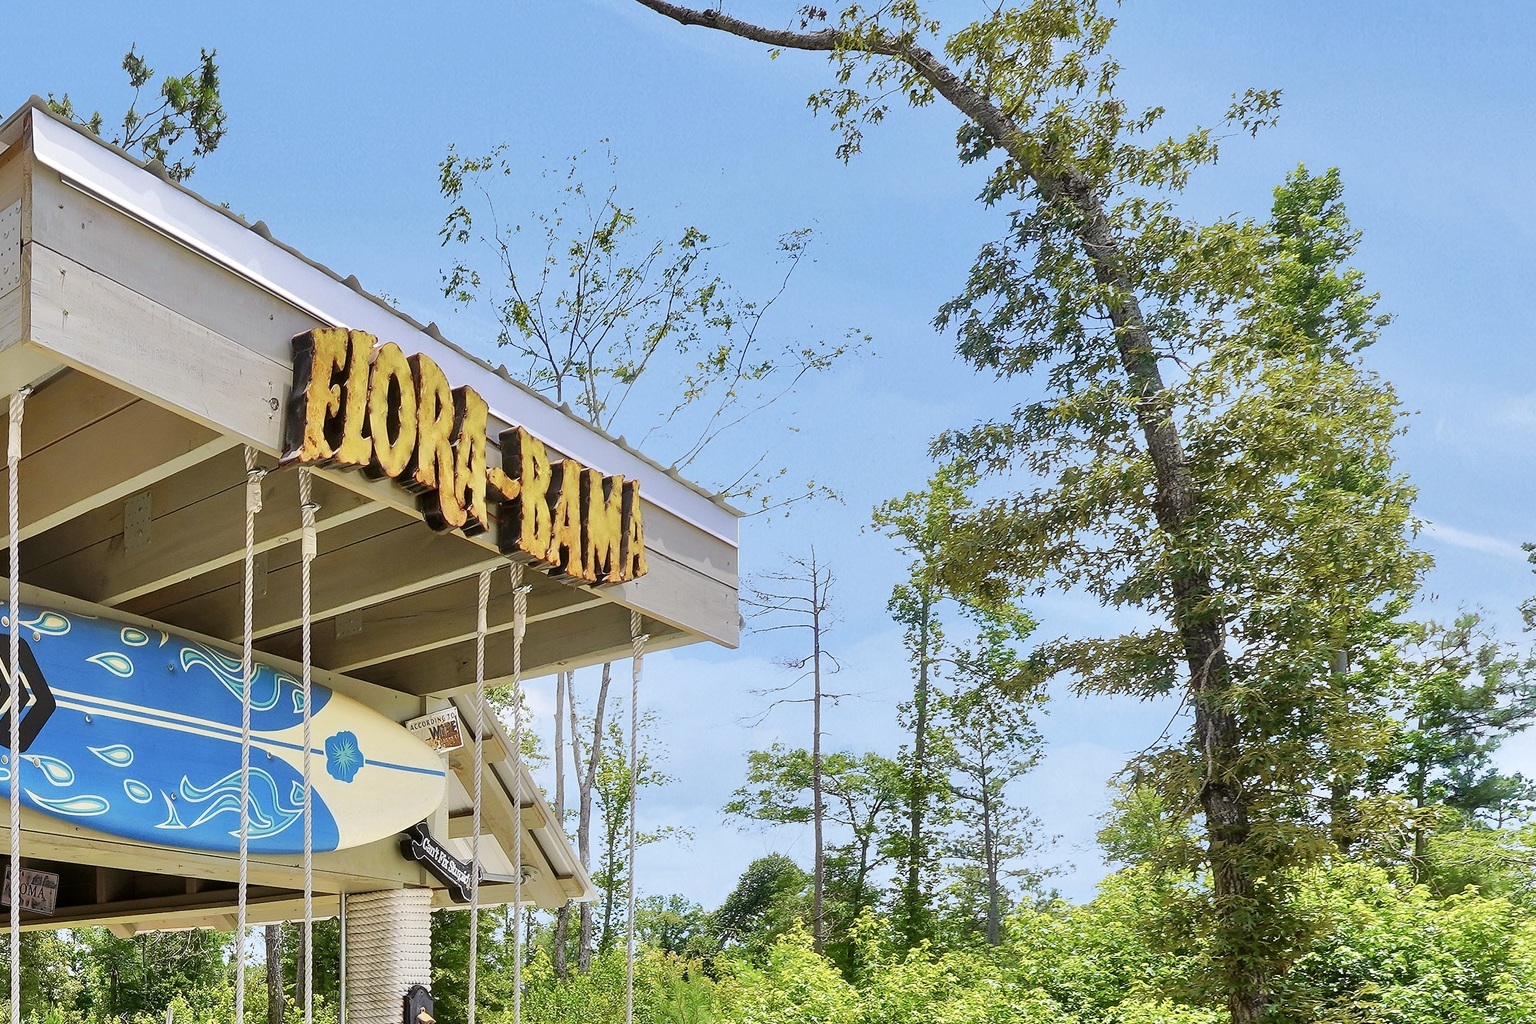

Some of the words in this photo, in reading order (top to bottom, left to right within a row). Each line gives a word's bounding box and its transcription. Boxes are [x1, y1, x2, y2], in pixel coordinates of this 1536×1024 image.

[410, 715, 446, 731] ACCORDING
[447, 712, 455, 721] TO
[19, 882, 47, 902] OMA
